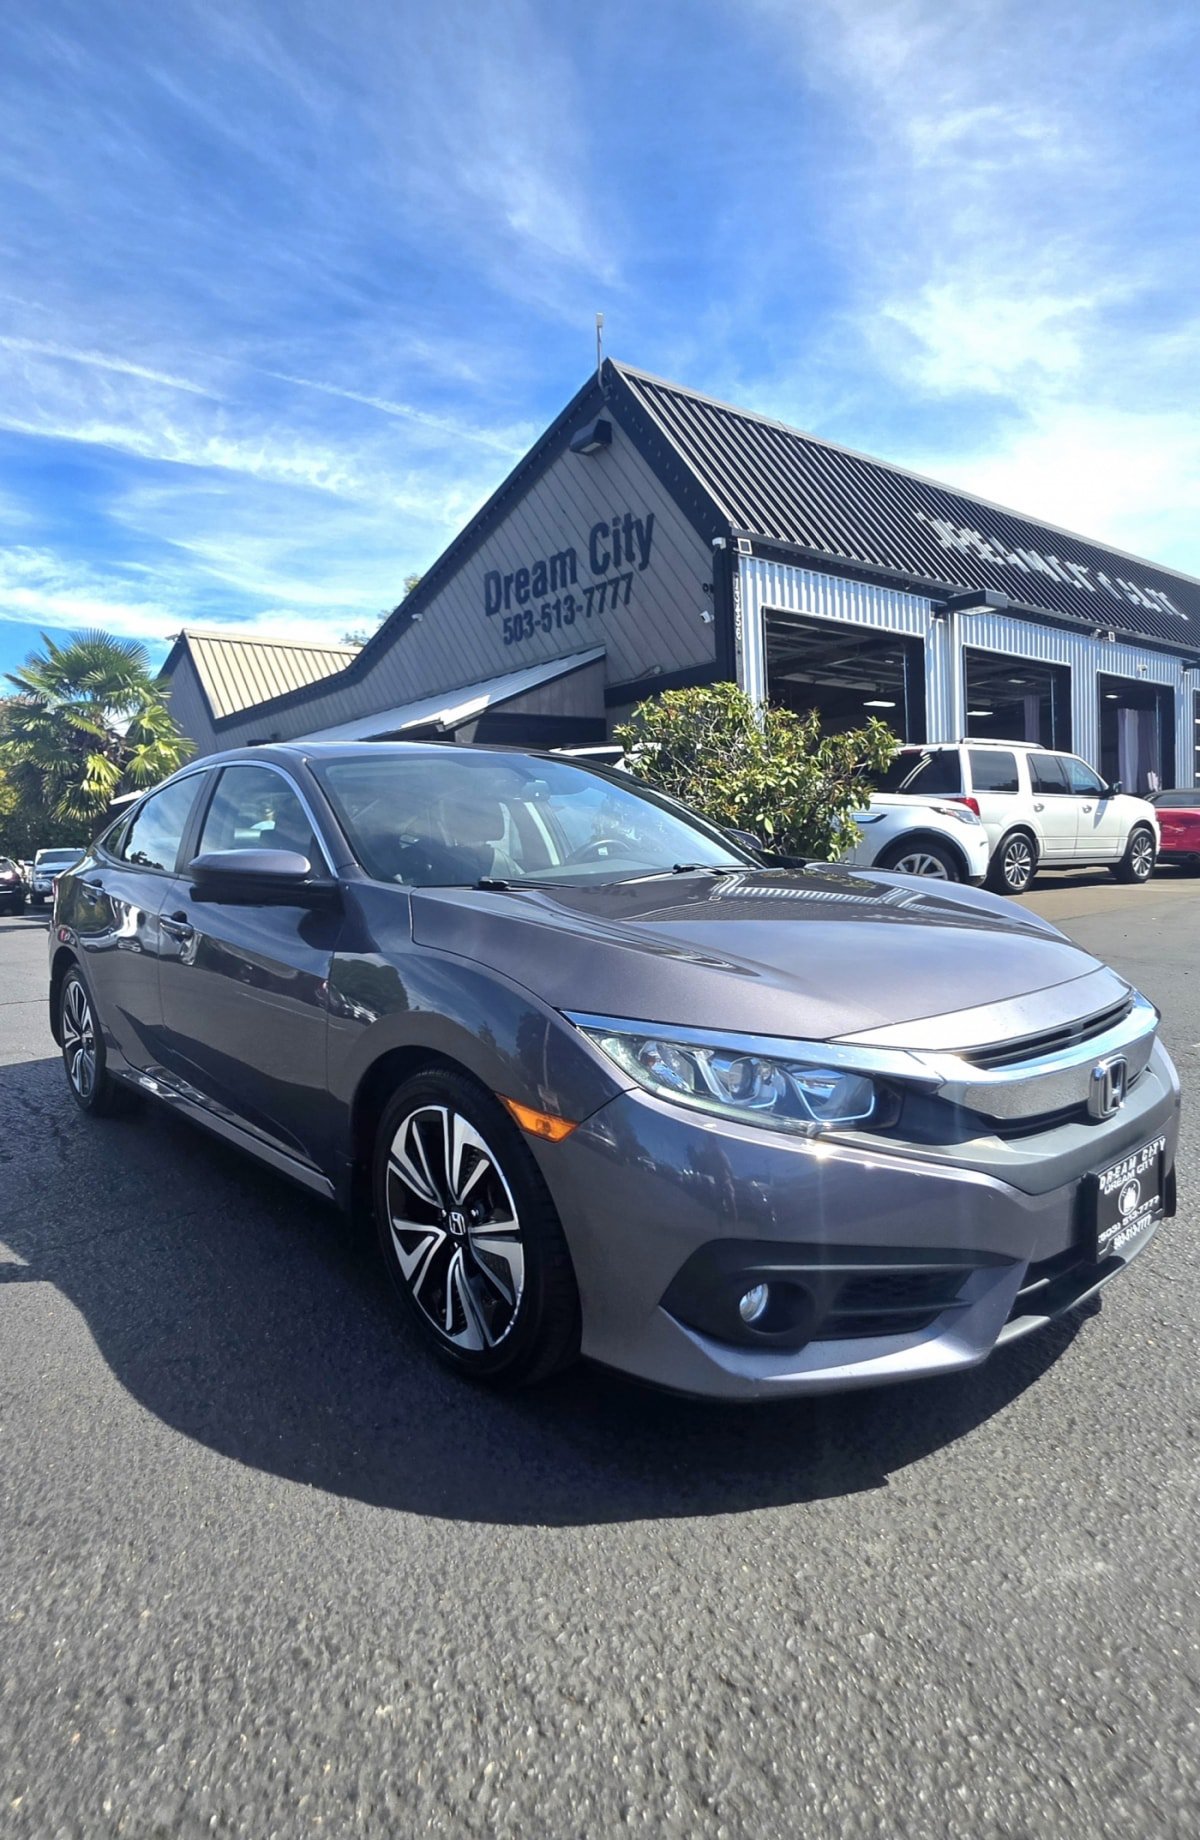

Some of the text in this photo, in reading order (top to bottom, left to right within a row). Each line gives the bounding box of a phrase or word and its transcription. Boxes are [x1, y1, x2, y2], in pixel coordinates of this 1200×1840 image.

[484, 513, 655, 617] Dream City
[503, 571, 634, 645] 503-513-7777
[1099, 1138, 1166, 1190] DREAM CITY
[1104, 1157, 1154, 1194] DREAM CITY
